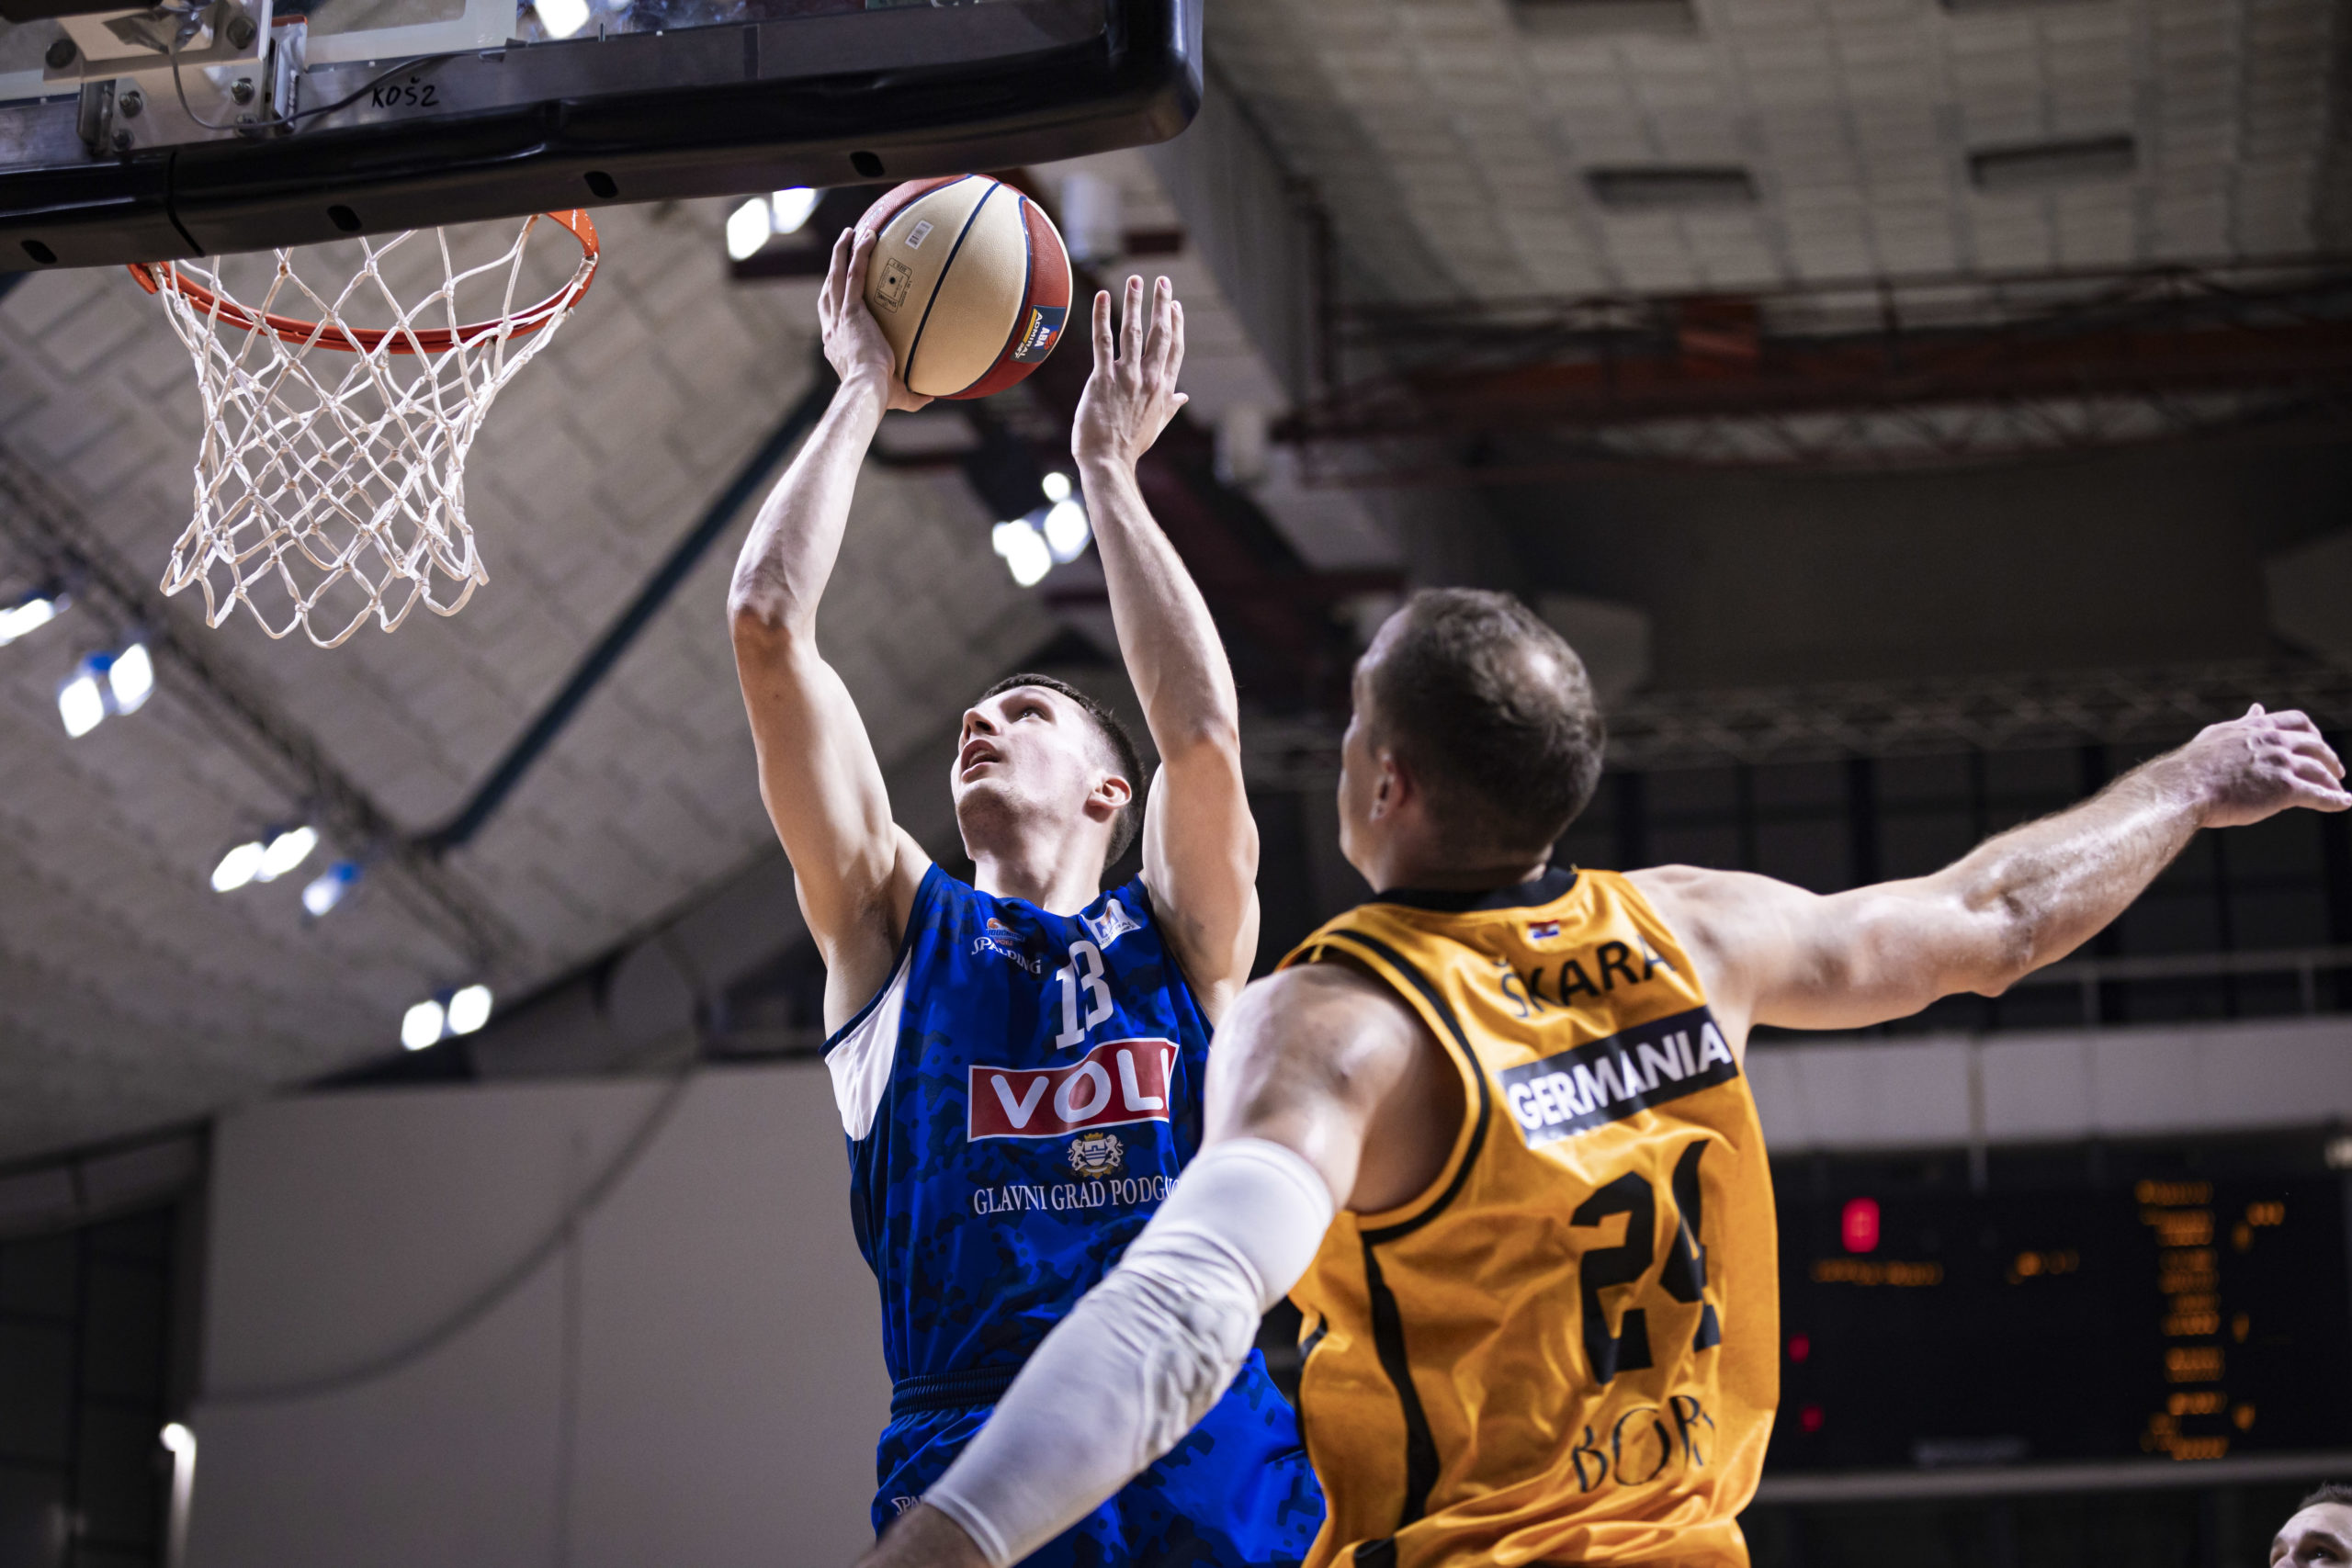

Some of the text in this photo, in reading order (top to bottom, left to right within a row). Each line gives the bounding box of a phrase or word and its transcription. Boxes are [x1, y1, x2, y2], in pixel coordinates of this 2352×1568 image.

[1017, 312, 1044, 357] ADMIRAL
[1034, 326, 1050, 347] ABA
[971, 936, 1042, 975] SPALDING
[1056, 940, 1114, 1049] 13
[1492, 933, 1677, 1019] ŠKARA
[990, 1048, 1170, 1129] VOLI
[1507, 1021, 1733, 1131] GERMANIA
[973, 1185, 1047, 1215] GLAVNI
[1051, 1180, 1106, 1212] GRAD
[1568, 1138, 1721, 1386] 24
